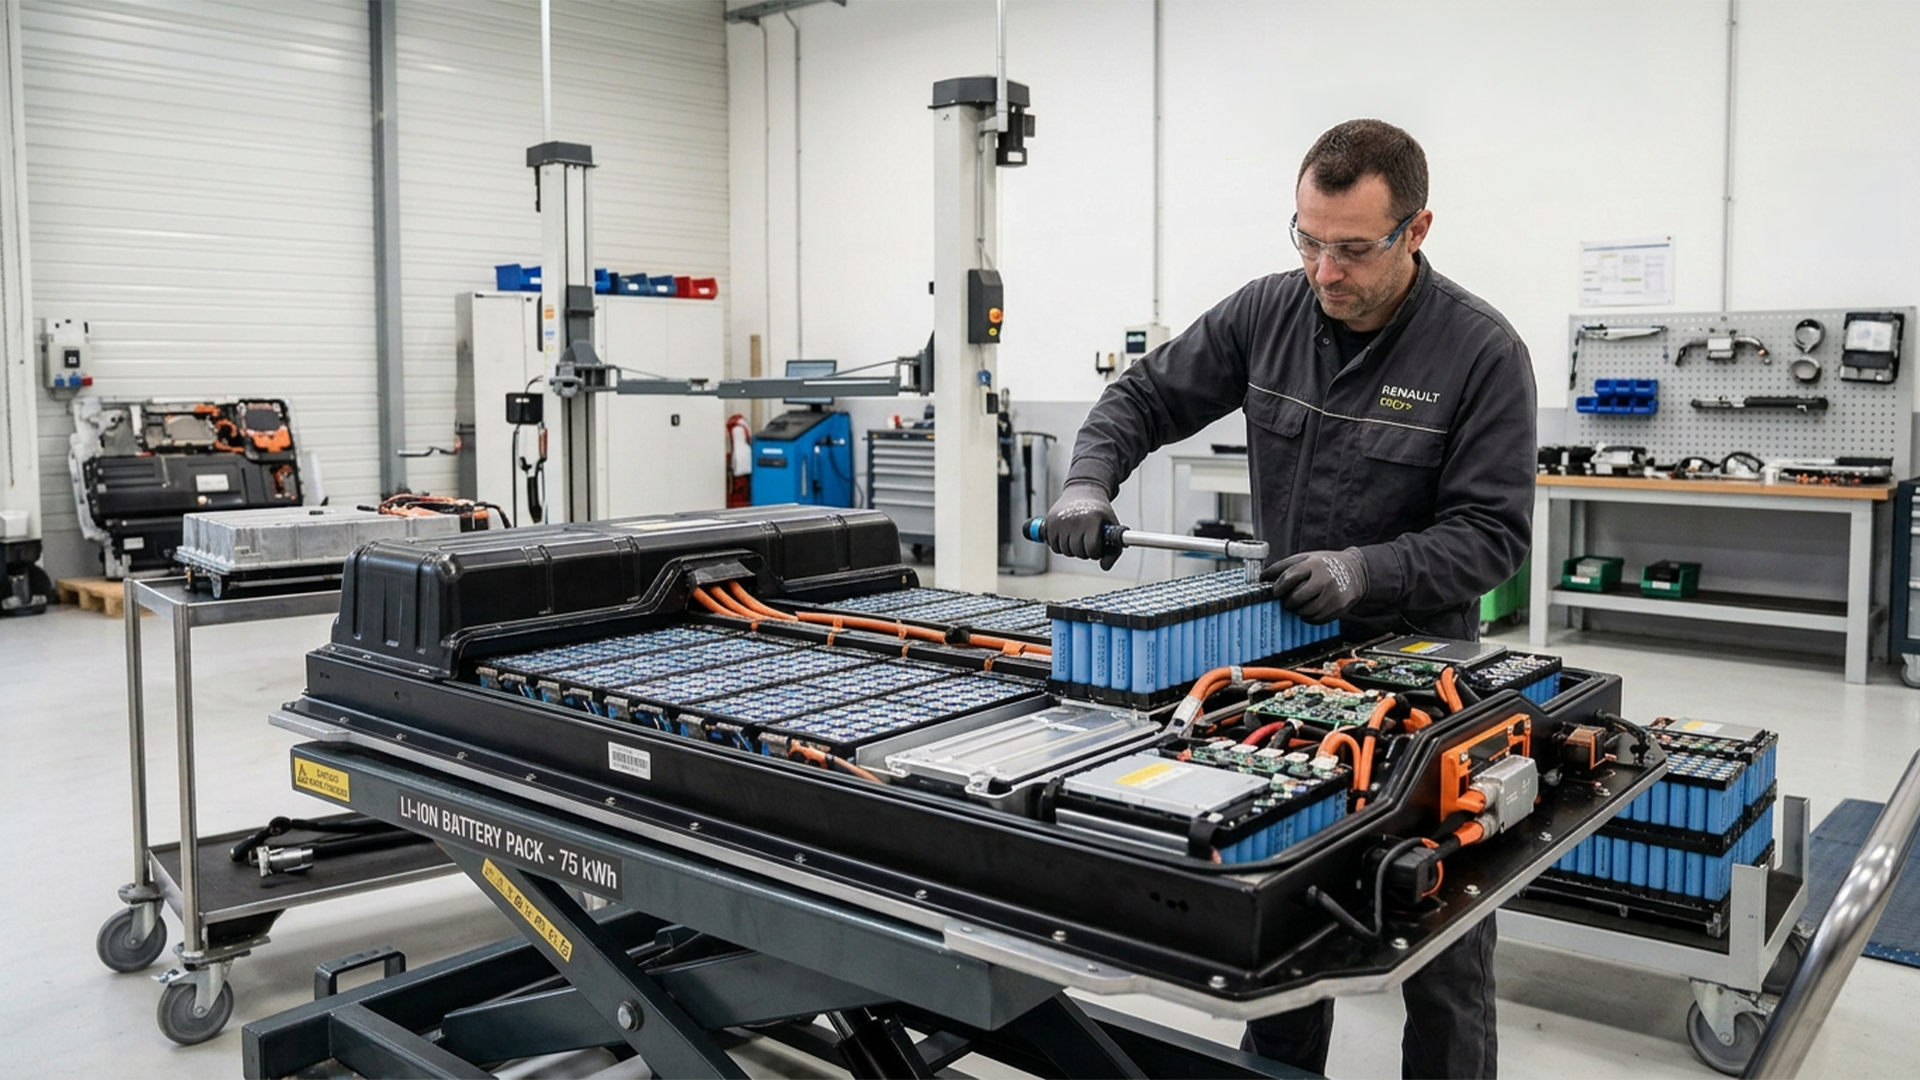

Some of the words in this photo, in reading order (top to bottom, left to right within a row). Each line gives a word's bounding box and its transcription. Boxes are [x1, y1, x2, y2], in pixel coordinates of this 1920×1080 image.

[1381, 384, 1441, 403] RENAULT
[400, 796, 439, 828] LI-ION
[442, 811, 502, 849] BATTERY
[506, 831, 545, 864] PACK
[559, 848, 578, 875] 75
[582, 857, 617, 889] kWh
